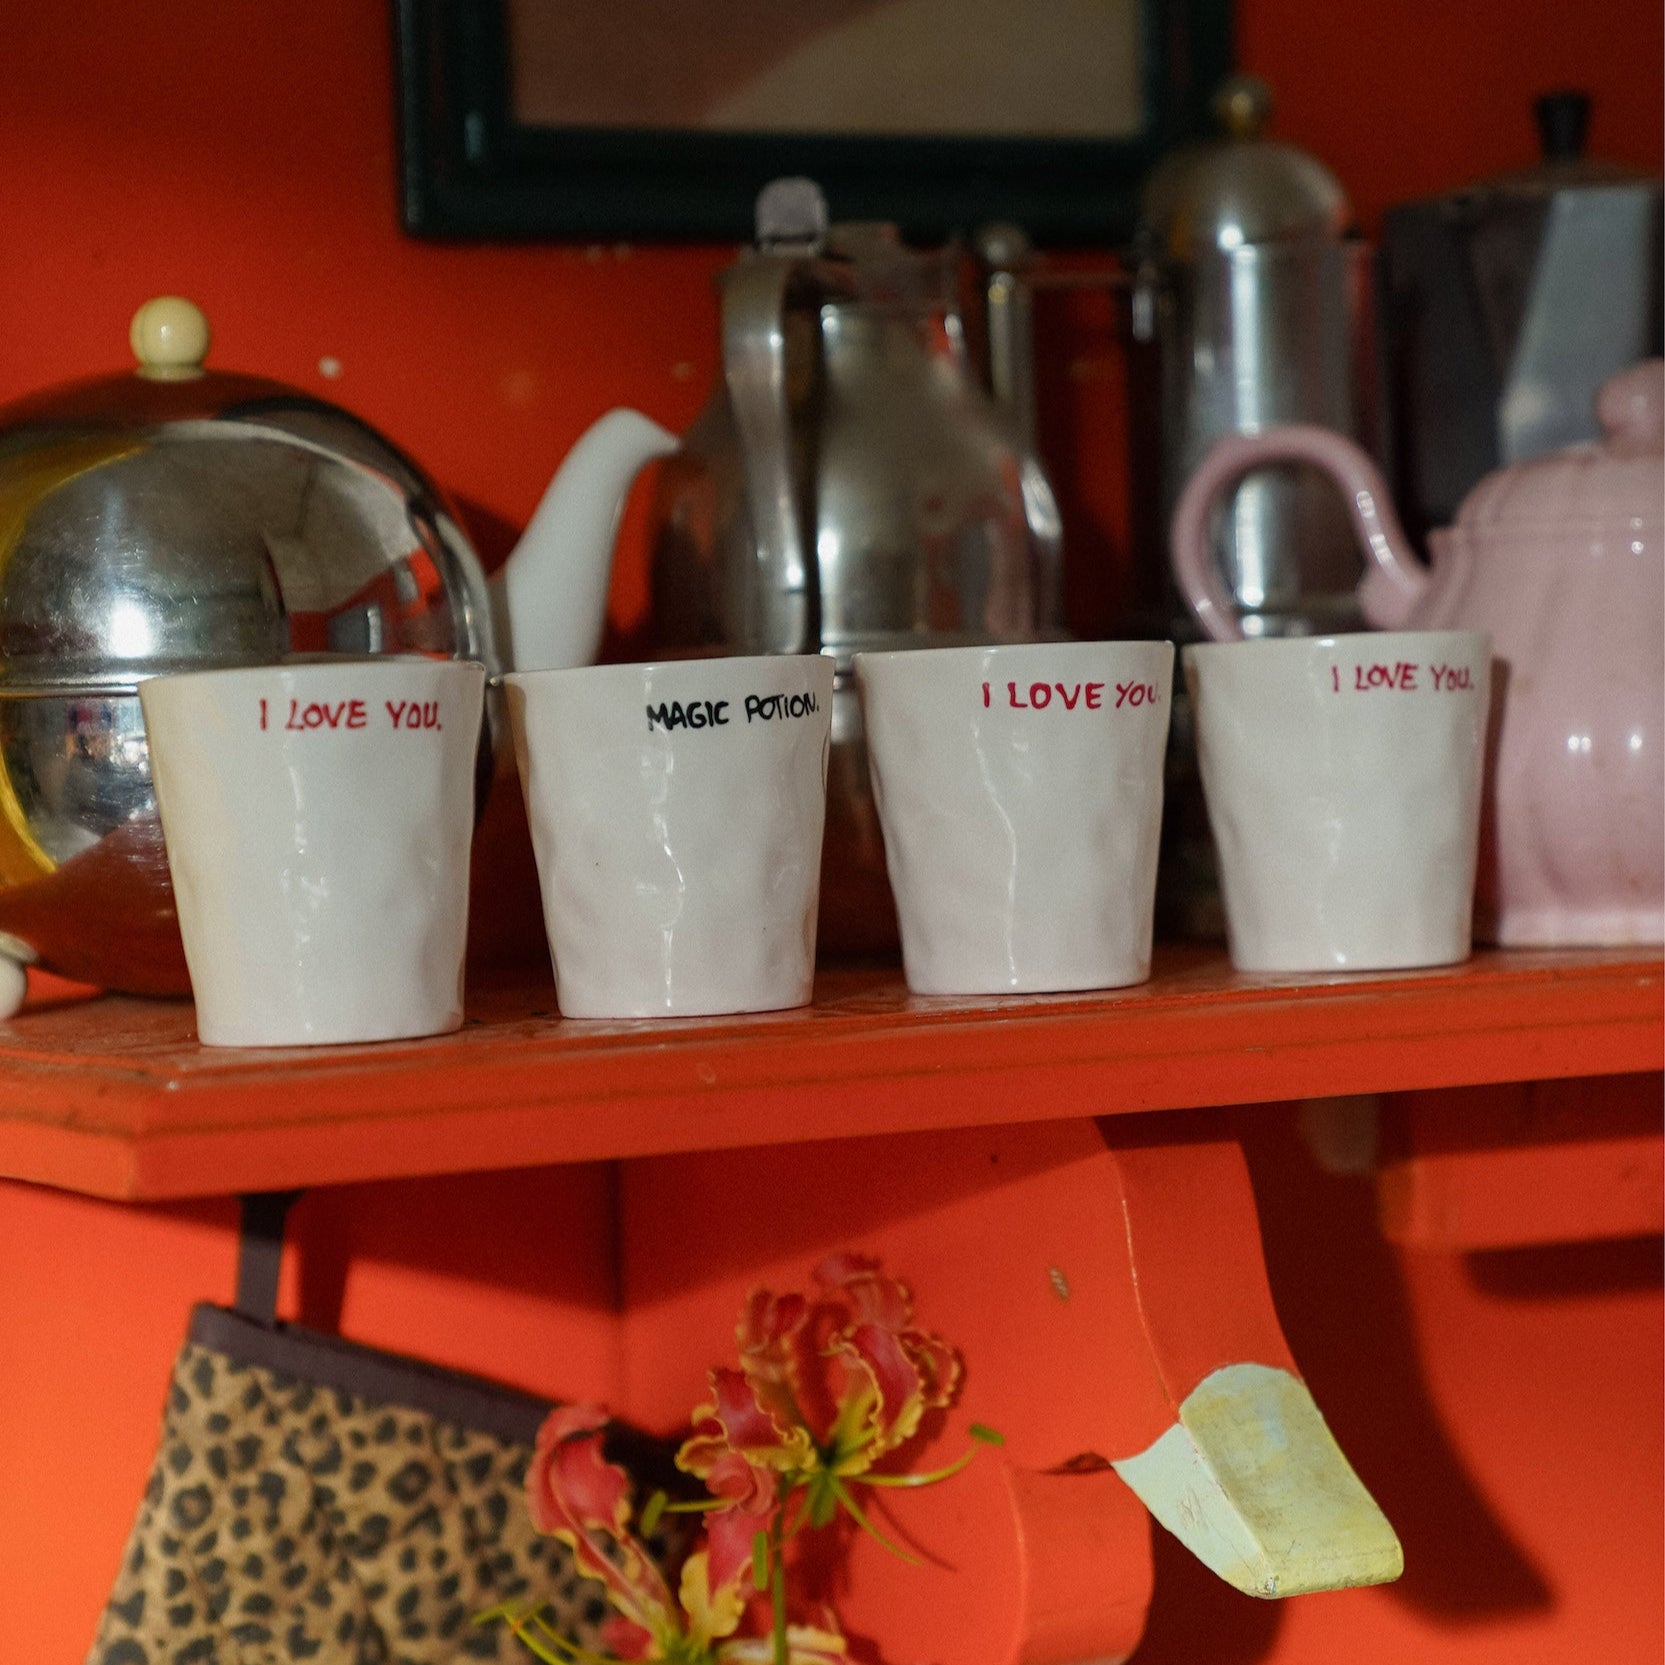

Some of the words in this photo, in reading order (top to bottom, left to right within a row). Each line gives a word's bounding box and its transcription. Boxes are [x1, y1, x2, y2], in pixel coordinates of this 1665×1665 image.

[1331, 664, 1340, 693] I
[1354, 662, 1419, 691] LOVE
[1430, 662, 1475, 692] YOU.
[982, 681, 991, 709] I
[1007, 681, 1105, 710] LOVE
[258, 698, 268, 731] I
[285, 698, 367, 731] LOVE
[385, 700, 442, 731] YOU.
[646, 700, 730, 732] MAGIC
[744, 692, 820, 724] POTION.
